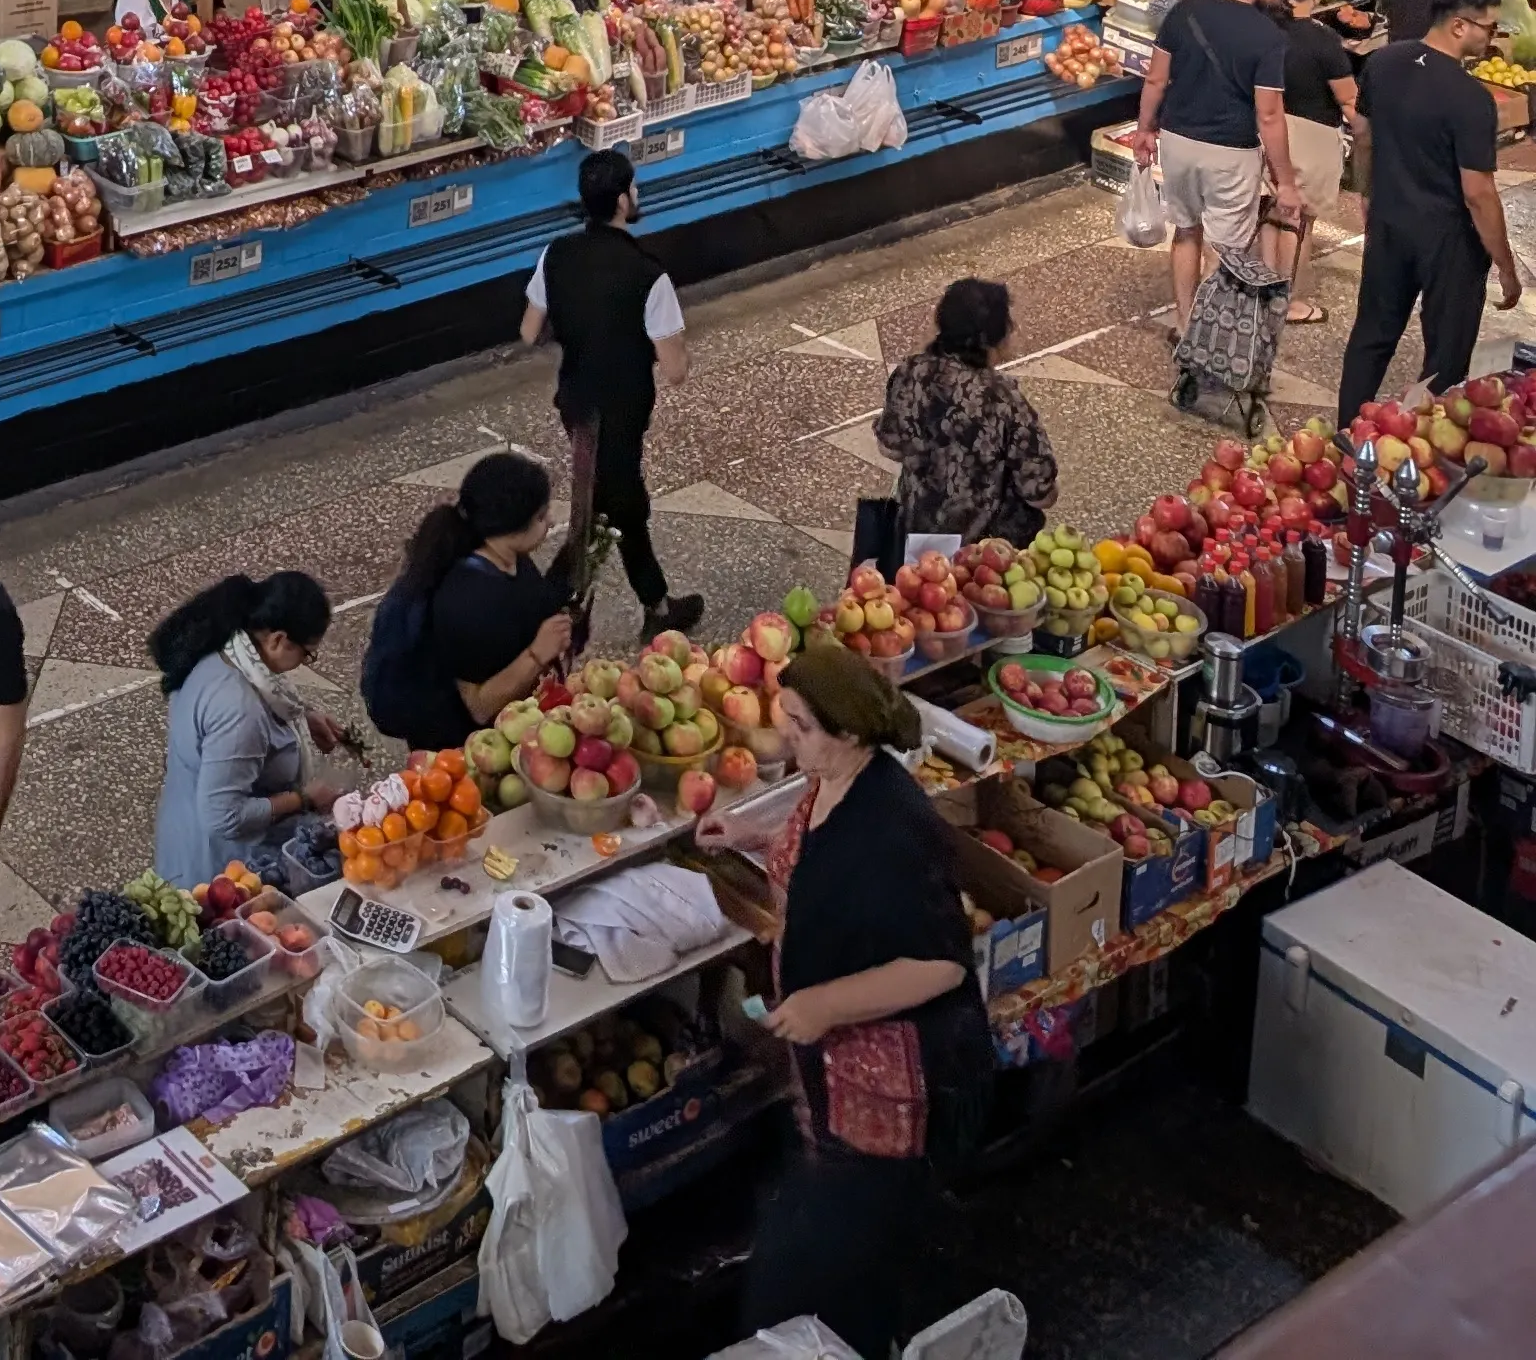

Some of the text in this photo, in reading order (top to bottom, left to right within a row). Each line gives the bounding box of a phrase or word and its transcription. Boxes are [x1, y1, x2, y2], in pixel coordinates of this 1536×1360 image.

[648, 141, 666, 154] 250
[433, 199, 451, 212] 251
[216, 257, 237, 271] 252
[628, 1109, 681, 1148] sweet
